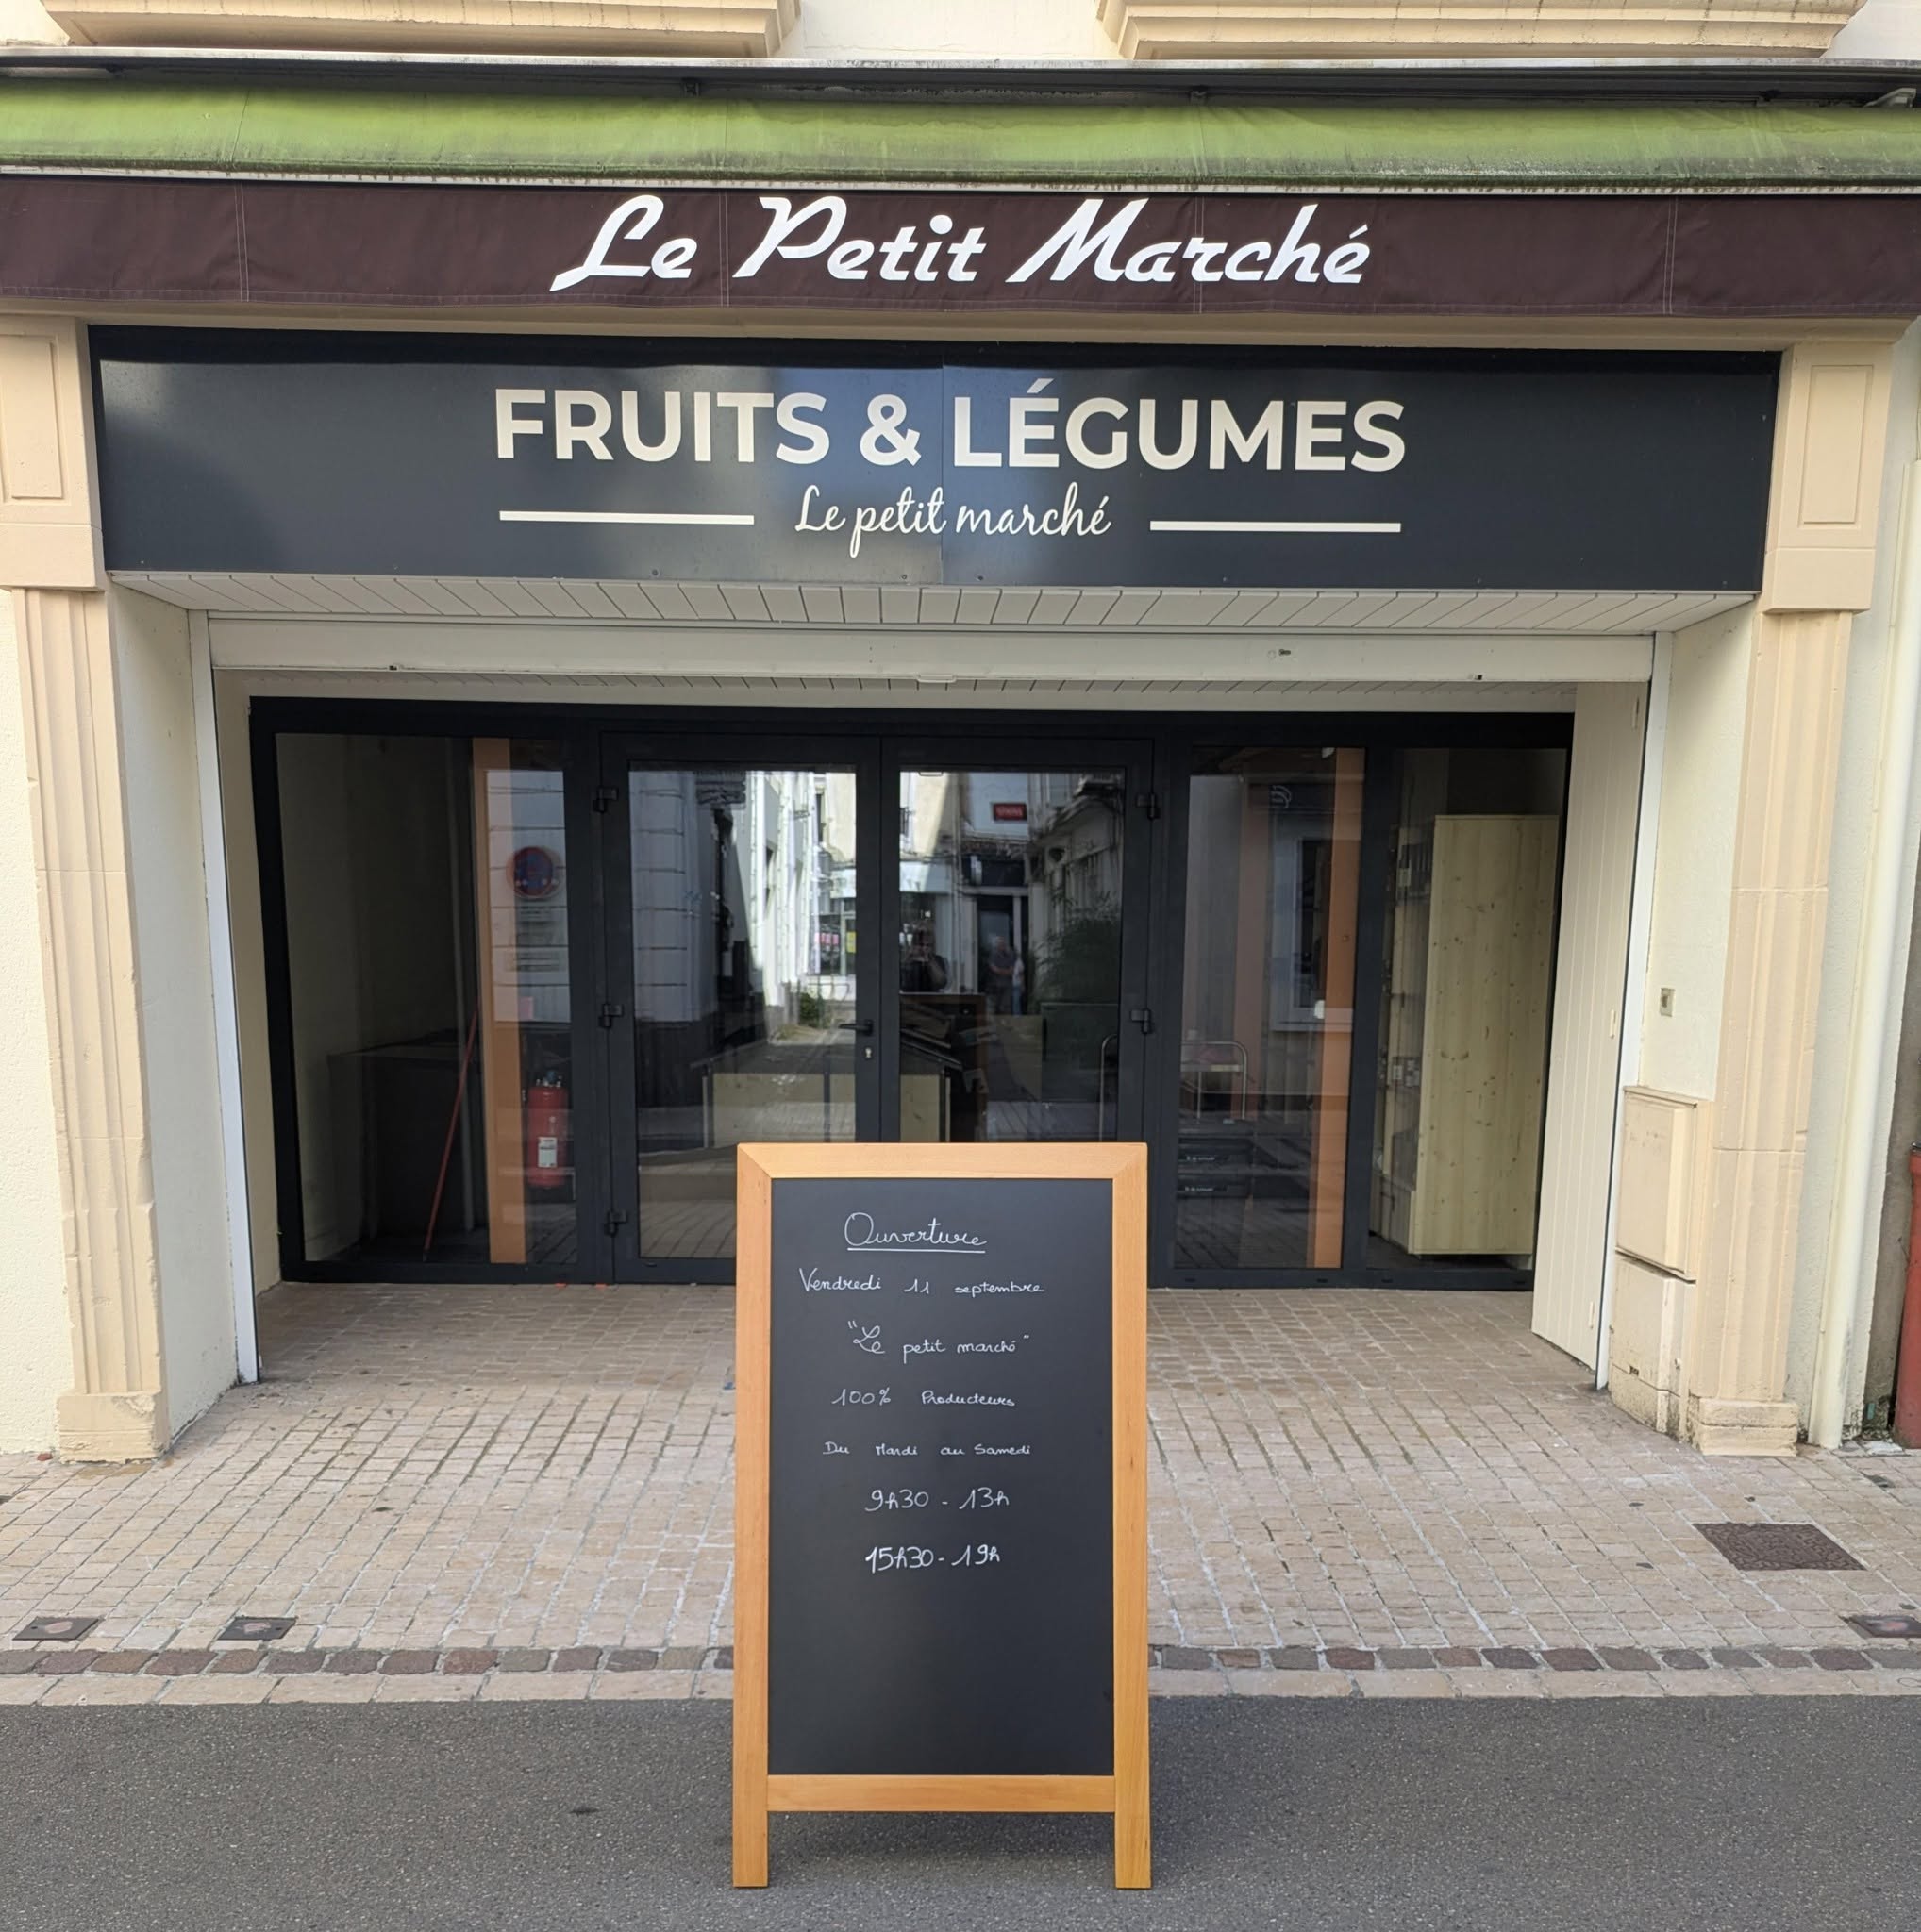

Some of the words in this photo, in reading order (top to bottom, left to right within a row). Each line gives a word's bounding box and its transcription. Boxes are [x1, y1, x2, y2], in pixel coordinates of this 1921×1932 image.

[550, 193, 698, 291] Le
[732, 195, 987, 283] Petit
[1005, 197, 1372, 285] Marché
[493, 386, 829, 467] FRUITS
[860, 393, 922, 468] &
[953, 377, 1407, 473] LÉGUMES
[794, 484, 843, 535] Le
[844, 486, 946, 558] petit
[956, 480, 1111, 539] marché
[844, 1212, 988, 1247] Ouverture
[799, 1268, 882, 1292] Vendredi
[904, 1278, 930, 1295] 11
[954, 1279, 1044, 1298] septembre
[903, 1338, 947, 1365] petit
[831, 1387, 892, 1407] 100%
[921, 1390, 1016, 1407] Producteurs
[822, 1441, 850, 1455] Du
[875, 1443, 919, 1456] Mardi
[940, 1446, 966, 1456] au
[974, 1443, 1031, 1456] Samedi
[865, 1489, 930, 1512] 9h30
[959, 1487, 1011, 1510] 13h
[950, 1543, 1002, 1567] 19h
